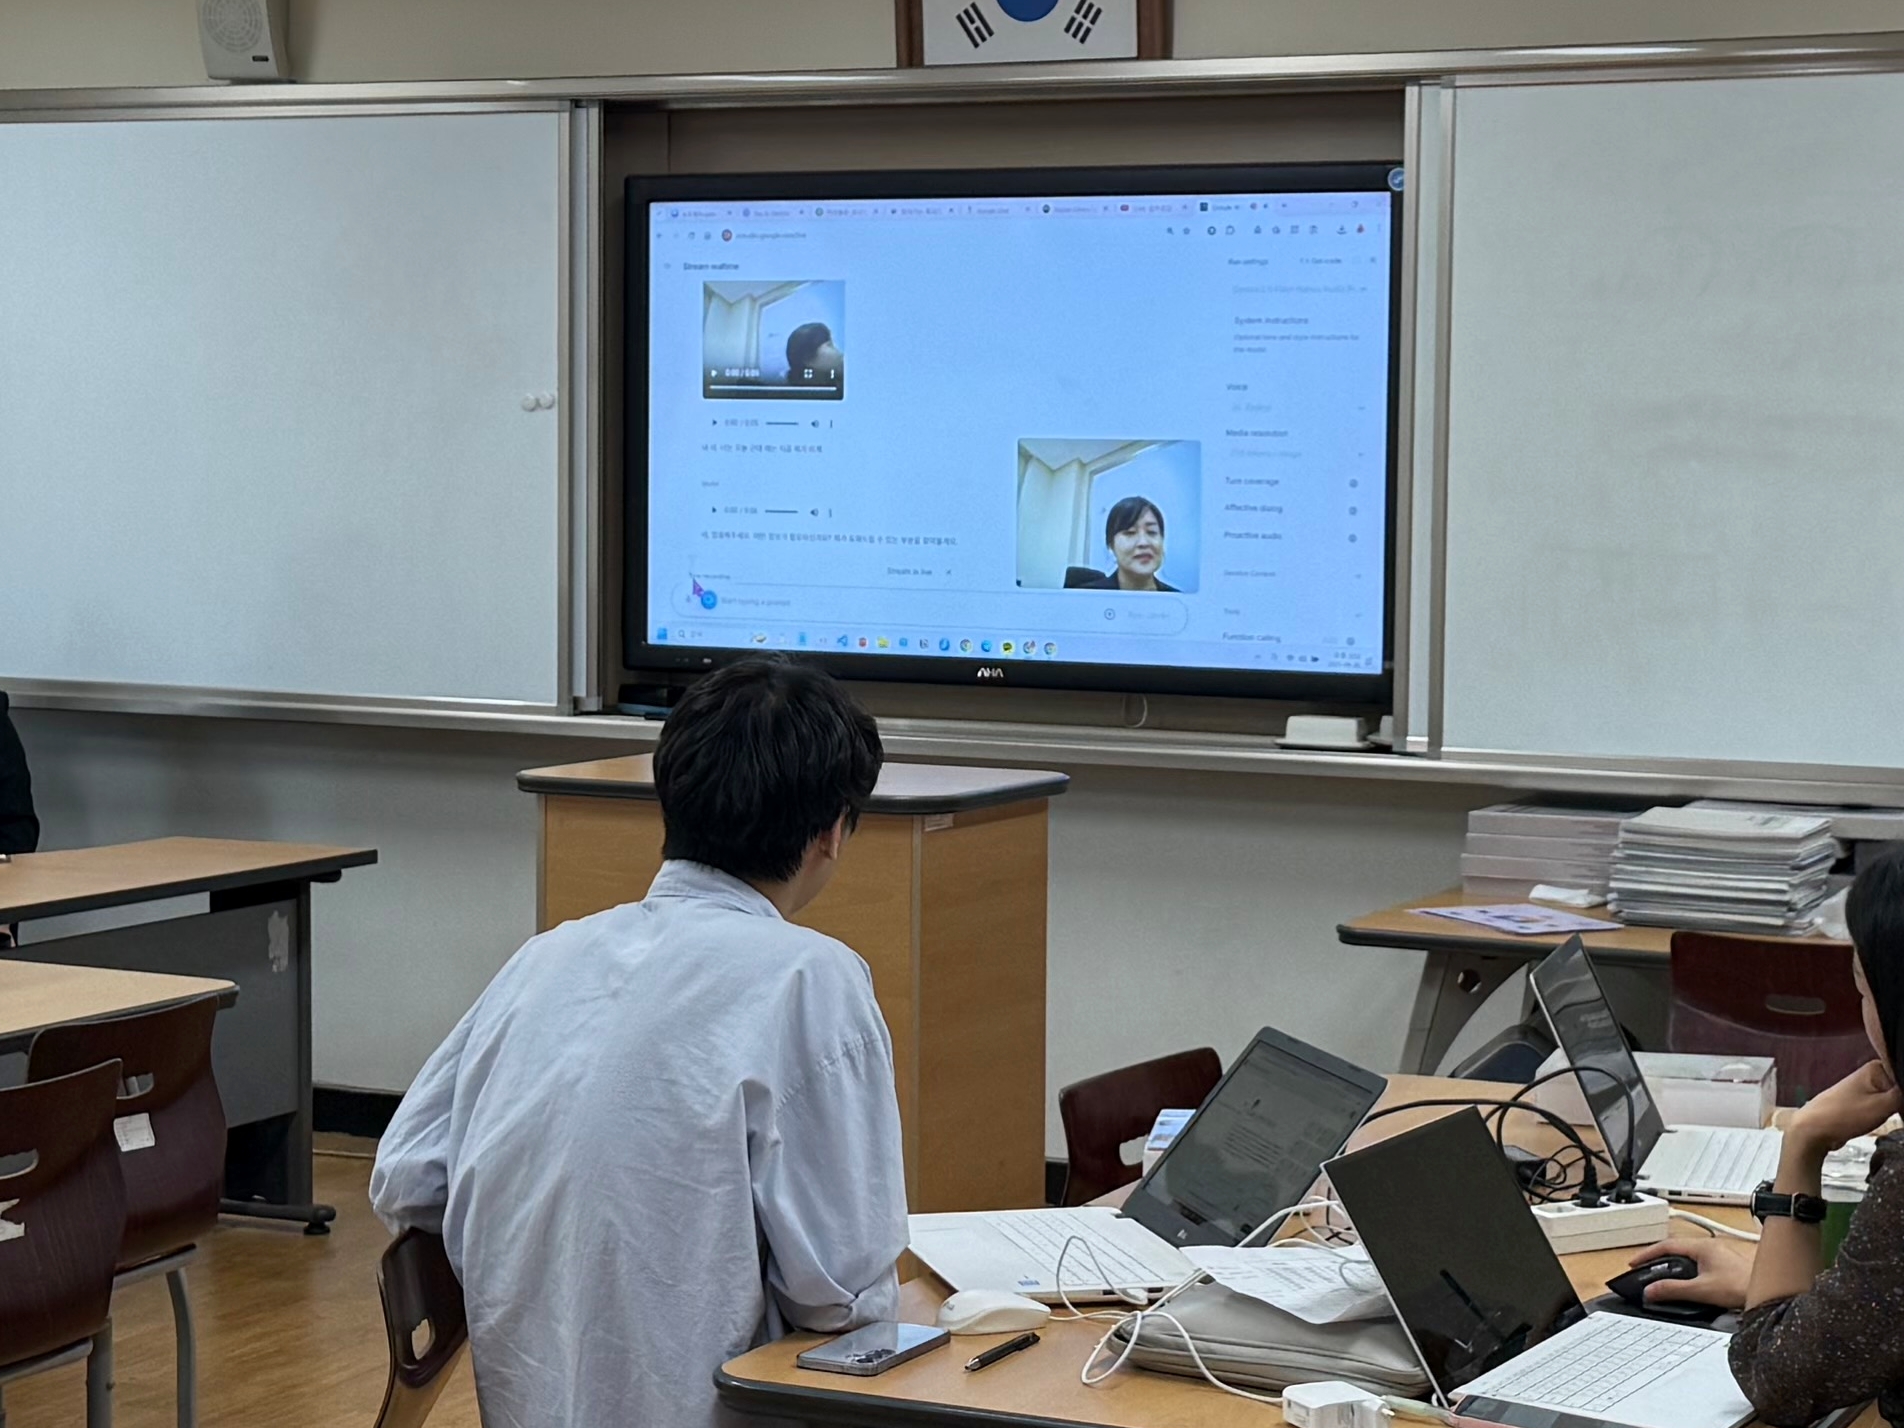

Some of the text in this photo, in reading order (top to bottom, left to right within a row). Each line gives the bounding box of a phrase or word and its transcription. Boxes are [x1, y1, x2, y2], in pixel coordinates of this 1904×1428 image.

[683, 262, 709, 270] Stream
[1225, 429, 1249, 437] Media
[1225, 476, 1242, 485] Turn
